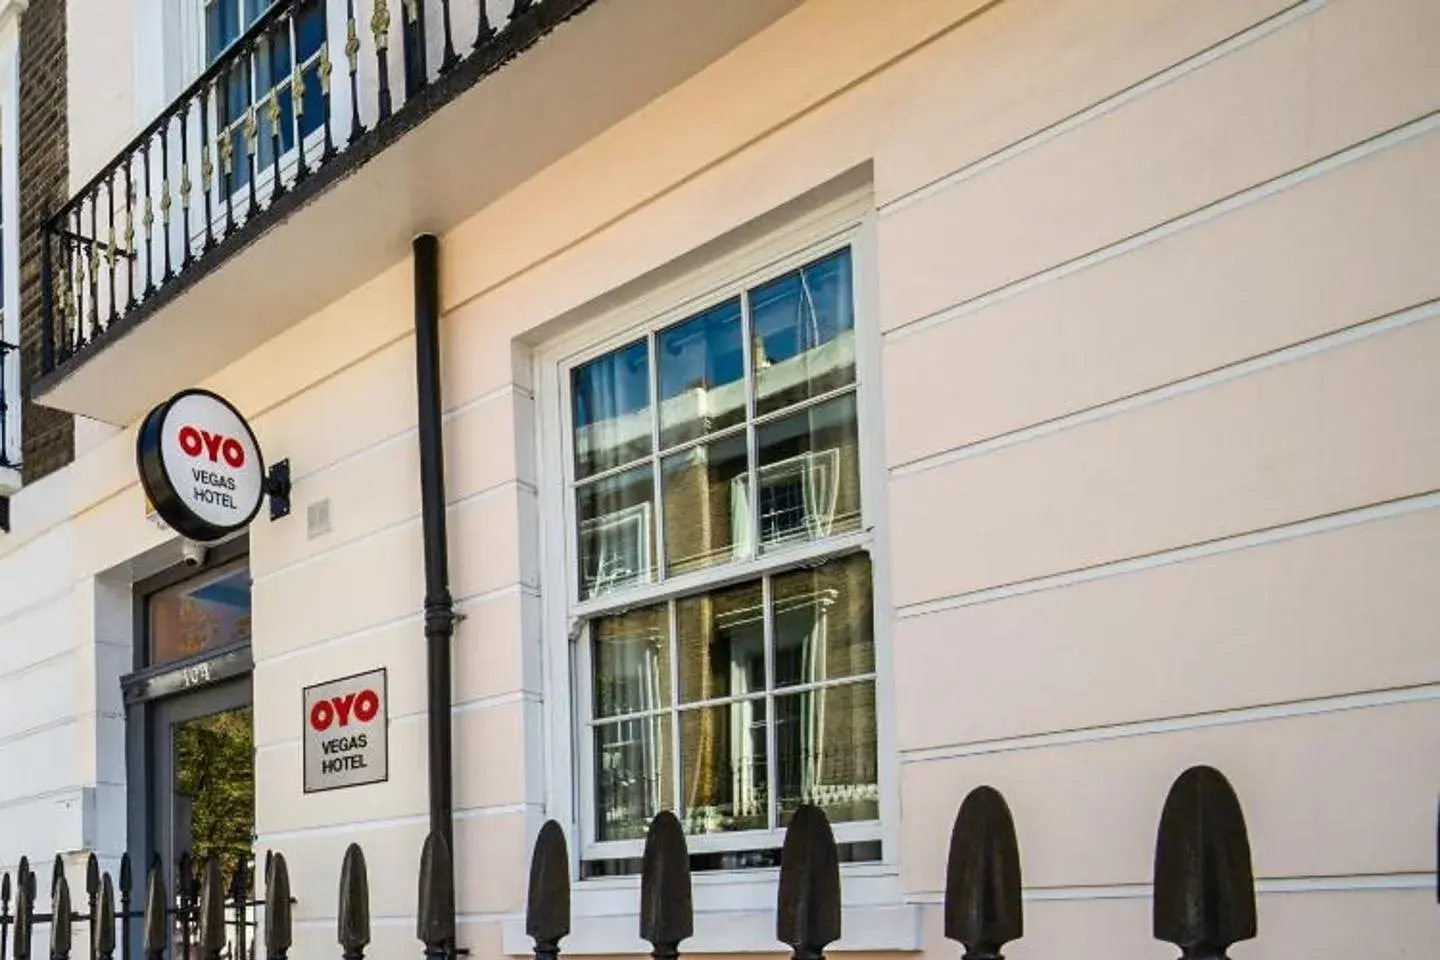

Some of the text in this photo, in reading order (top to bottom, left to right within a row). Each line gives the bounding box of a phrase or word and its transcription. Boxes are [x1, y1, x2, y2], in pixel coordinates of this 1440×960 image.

[178, 425, 245, 469] OYO
[192, 468, 236, 491] VEGAS
[193, 487, 238, 510] HOTEL
[310, 689, 380, 732] OYO
[321, 733, 368, 755] VEGAS
[321, 754, 368, 774] HOTEL
